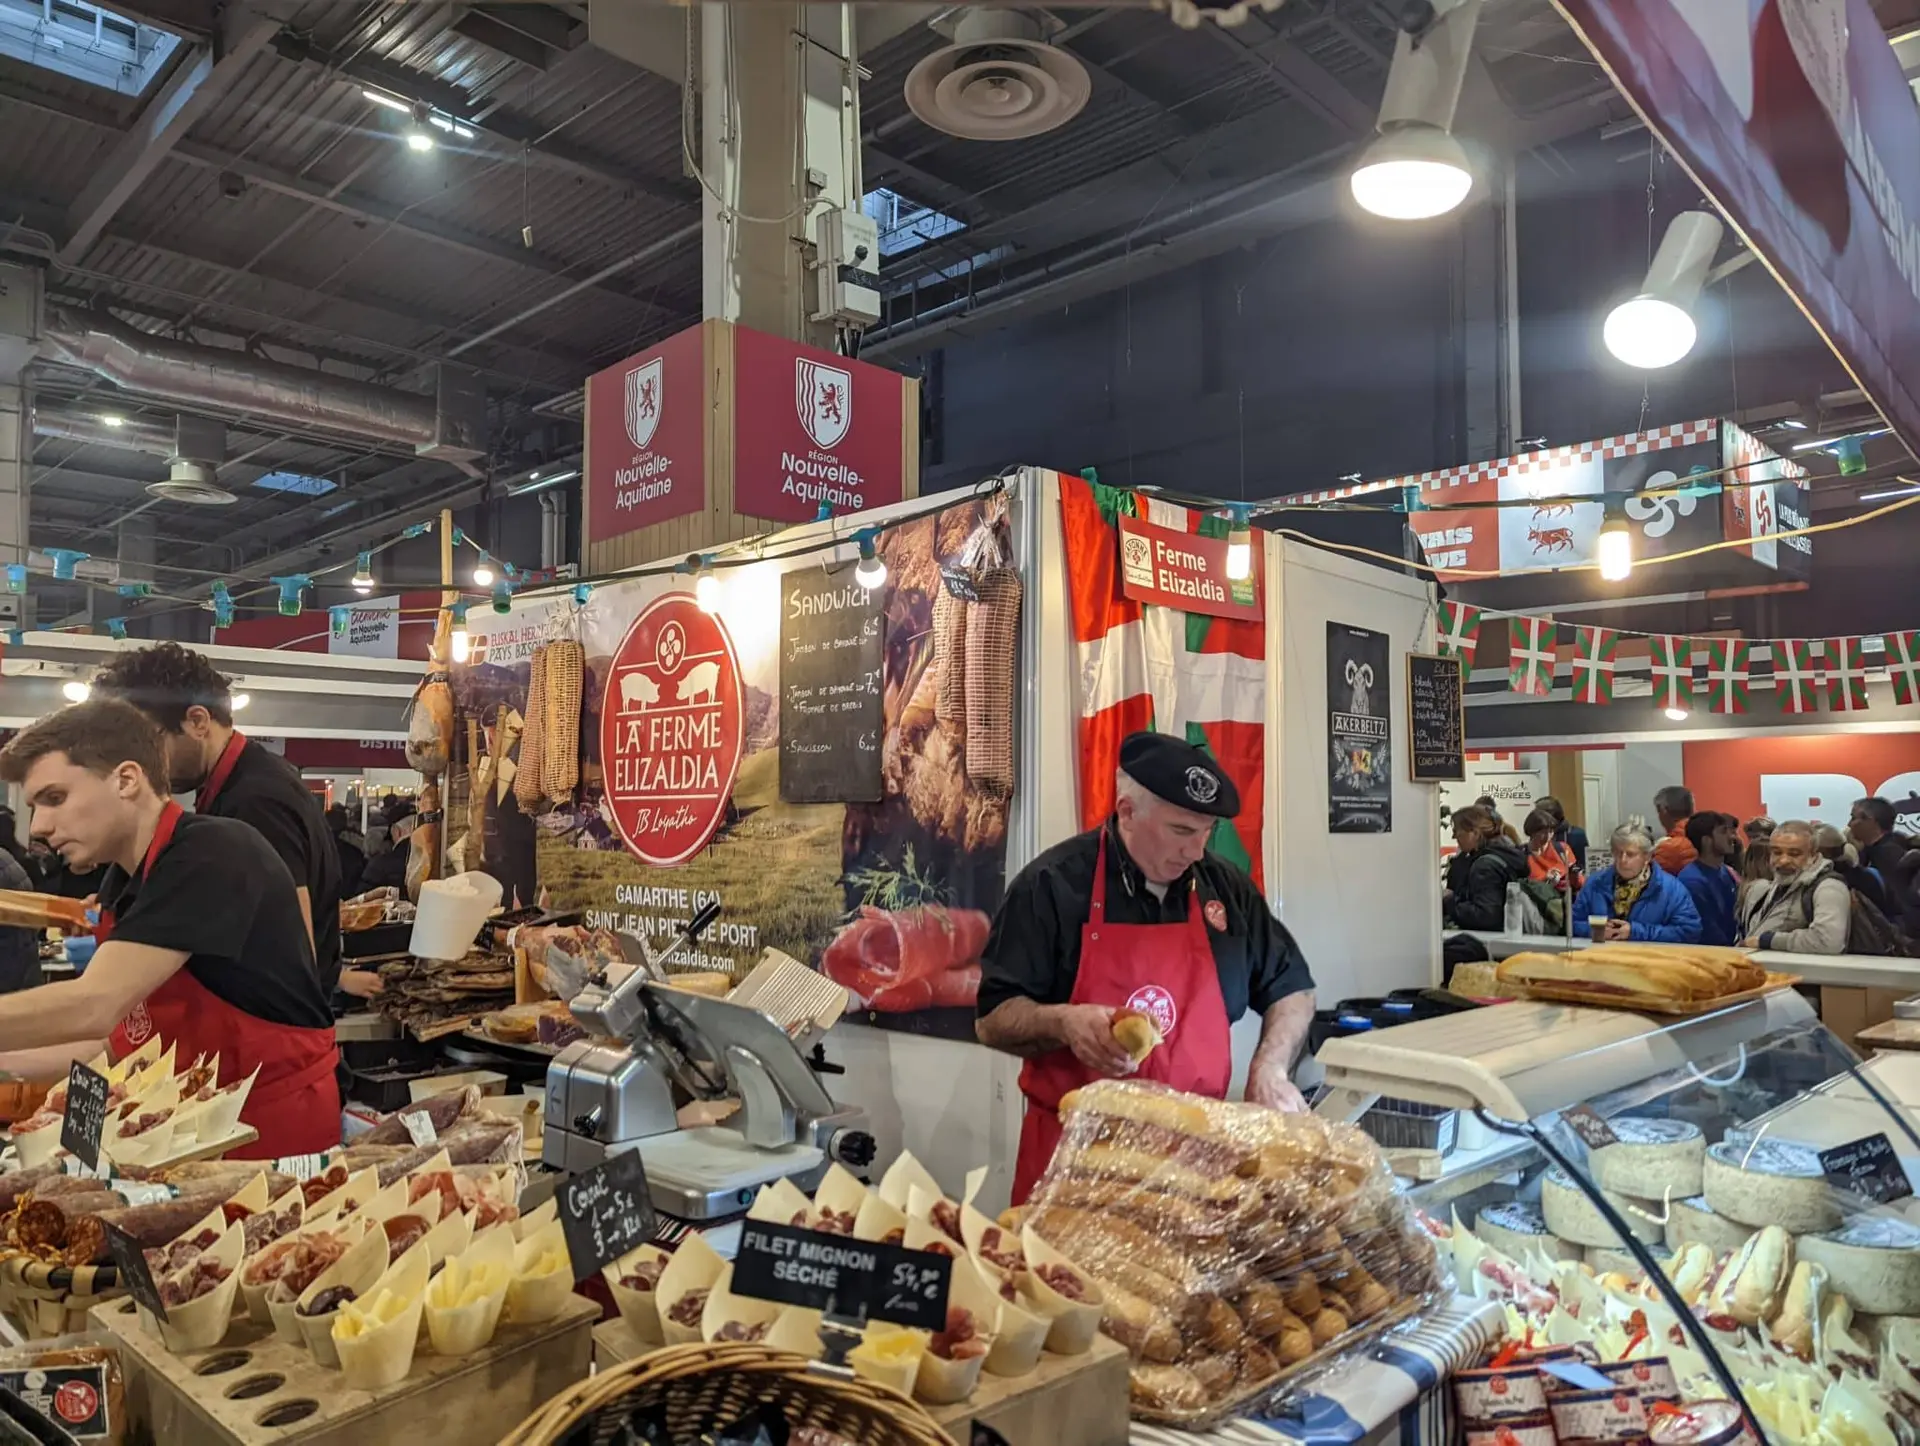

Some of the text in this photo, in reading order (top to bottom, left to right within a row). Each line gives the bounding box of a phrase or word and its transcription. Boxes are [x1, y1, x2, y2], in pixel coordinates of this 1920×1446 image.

[615, 456, 672, 488] Nouvelle-
[781, 453, 865, 486] Nouvelle-
[808, 451, 839, 465] RÉGION
[615, 480, 672, 510] Aquitaine
[781, 480, 864, 510] Aquitaine
[1155, 540, 1207, 572] Ferme
[1158, 568, 1226, 602] Elizaldia
[350, 633, 381, 646] Aquitaine
[488, 644, 512, 662] PAYS
[491, 629, 519, 647] EUSKAL
[615, 712, 722, 754] LA FERME
[1334, 715, 1386, 735] AKERBELTZ
[614, 754, 720, 793] ELIZALDIA
[1481, 783, 1499, 792] LIN
[615, 884, 690, 909] GAMARTHE
[586, 909, 620, 932] SAINT
[621, 913, 655, 938] JEAN
[720, 923, 758, 948] PORT
[743, 1231, 877, 1272] FILET MIGNON
[773, 1260, 840, 1289] SÉCHÉ
